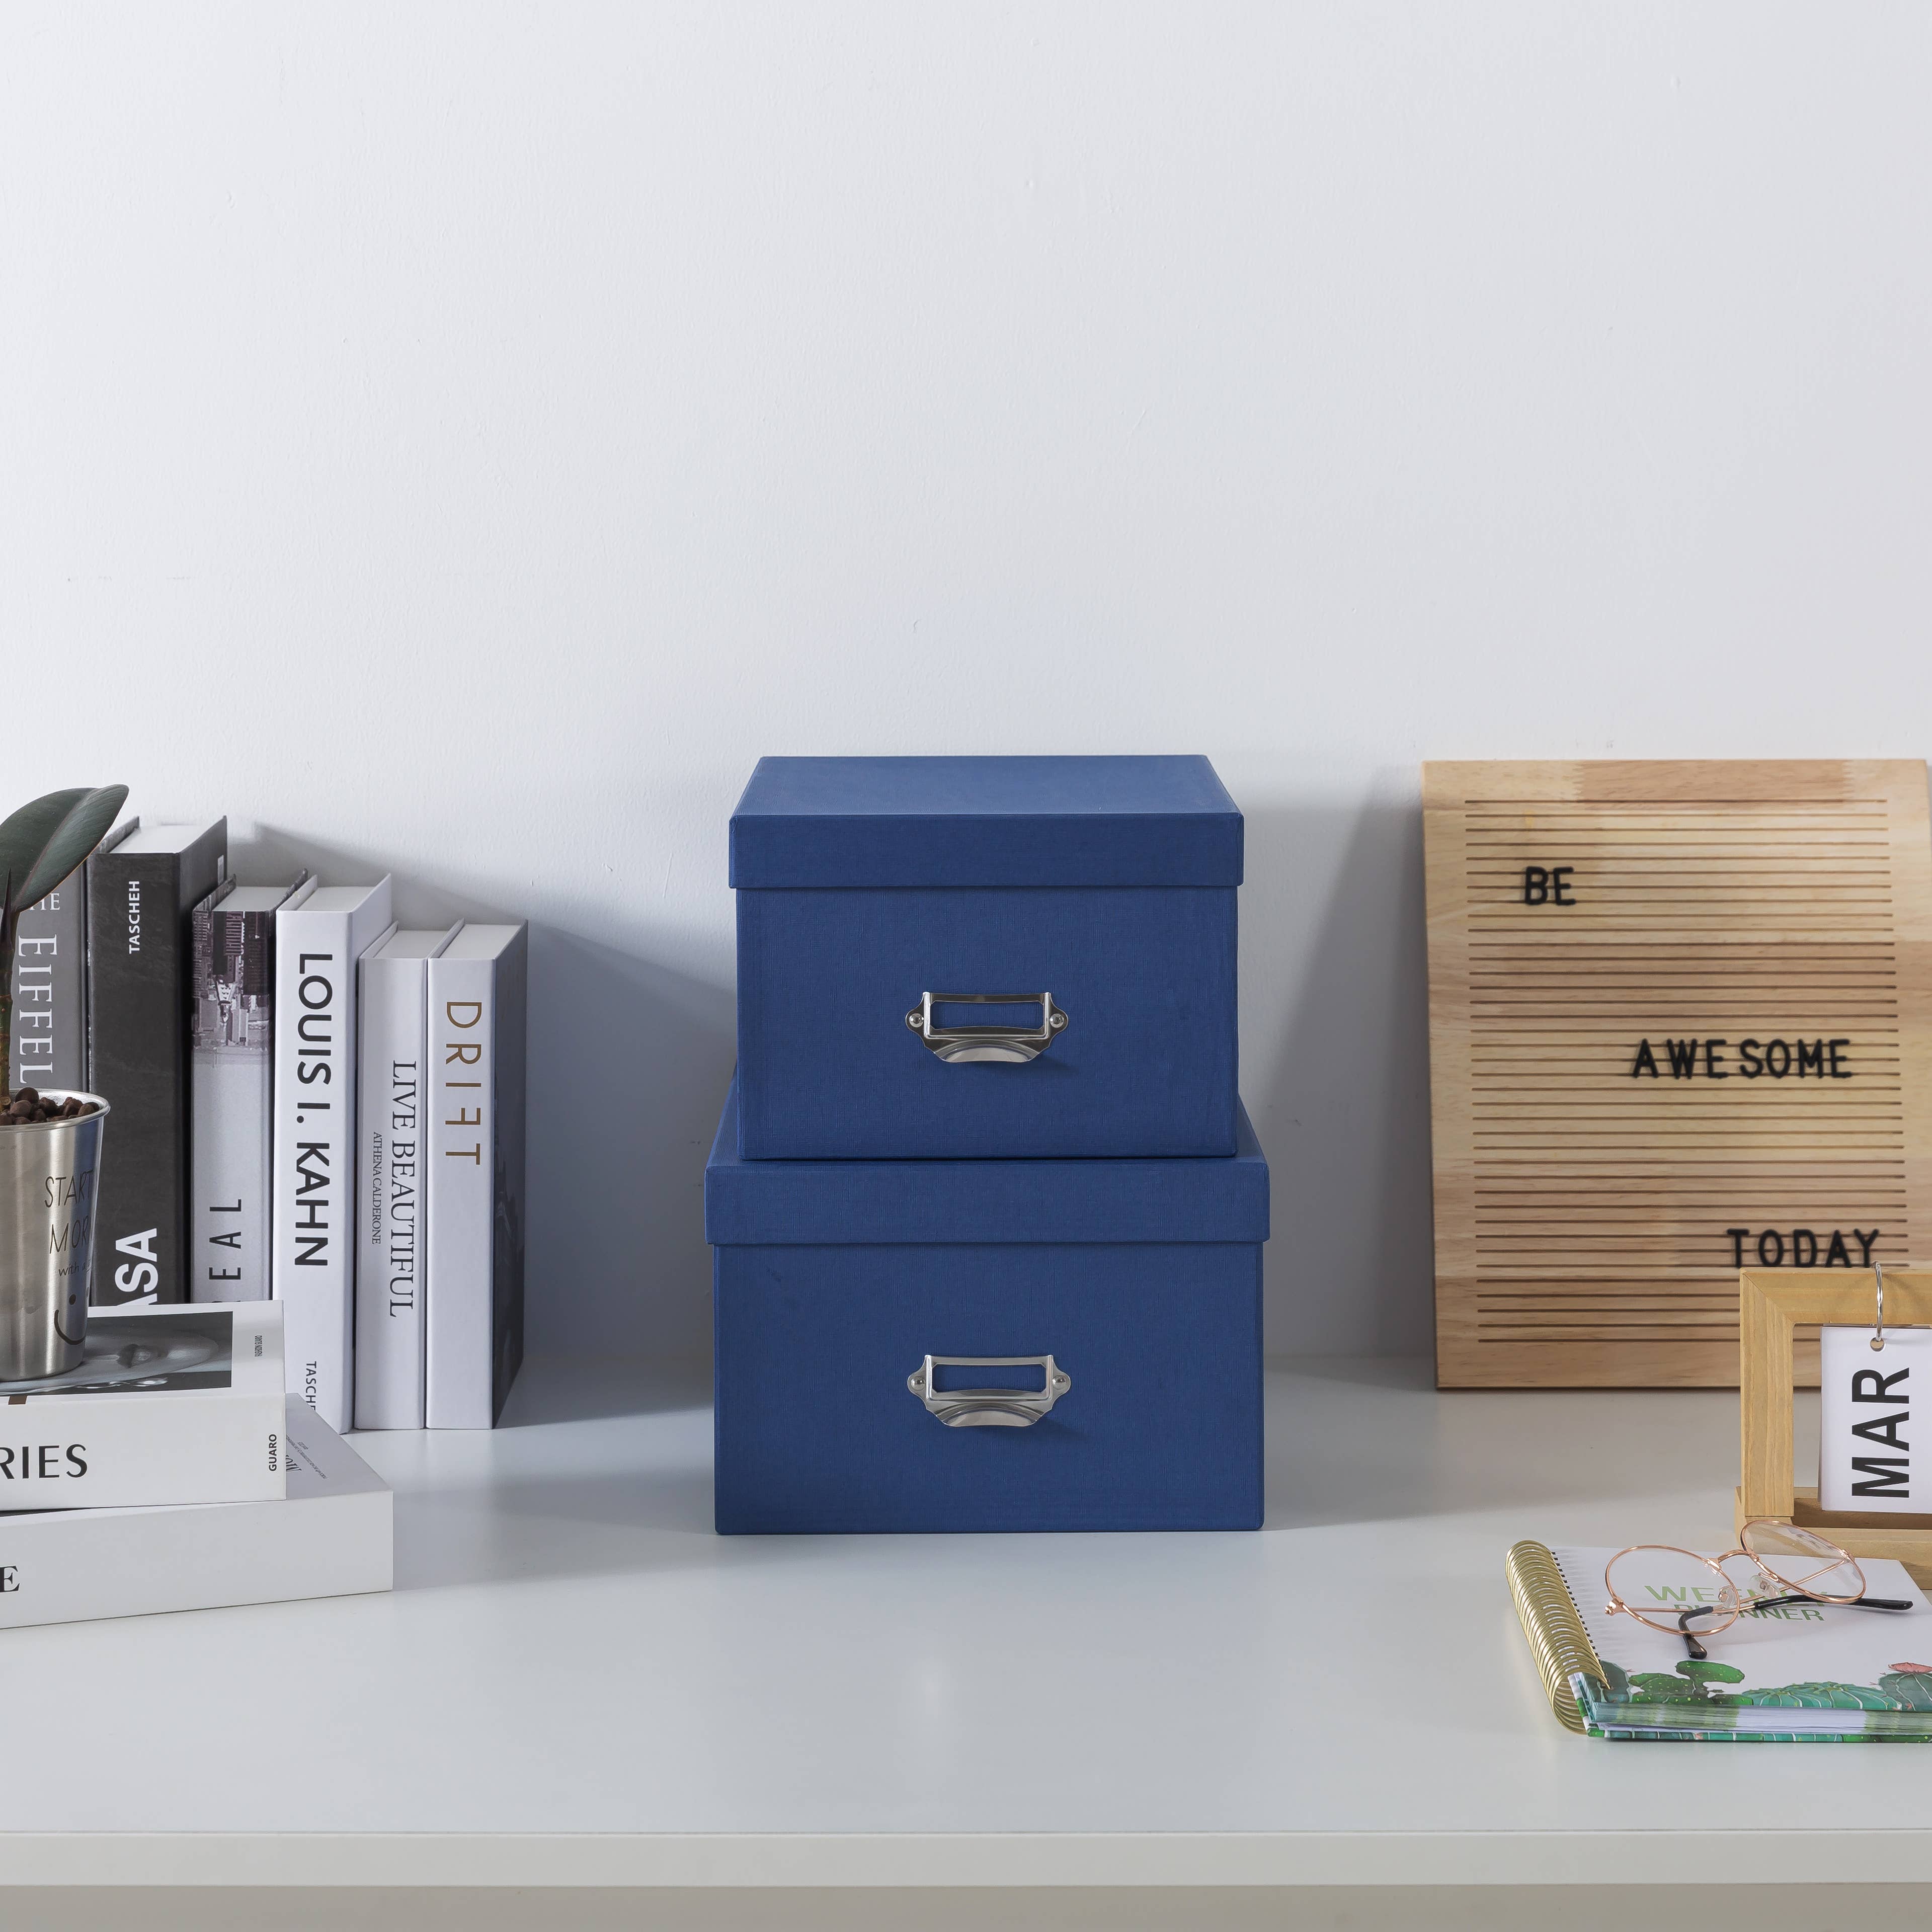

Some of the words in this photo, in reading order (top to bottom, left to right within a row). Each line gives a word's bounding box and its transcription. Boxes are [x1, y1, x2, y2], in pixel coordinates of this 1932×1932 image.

[1524, 866, 1576, 906] BE
[18, 934, 57, 1084] EIFFEL
[297, 953, 333, 1085] LOUIS
[445, 1002, 482, 1166] DRIFT
[1632, 1038, 1853, 1080] AWESOME
[296, 1102, 331, 1123] I.
[392, 1060, 417, 1130] LIVE
[44, 1168, 94, 1208] START
[373, 1132, 382, 1177] ATHENA
[294, 1142, 330, 1266] KAHN
[372, 1177, 382, 1245] CALDERONE
[389, 1140, 415, 1318] BEAUTIFUL
[58, 1261, 79, 1277] with
[208, 1198, 242, 1303] EAL
[1727, 1228, 1880, 1269] TODAY
[269, 1434, 277, 1472] GUARO
[1852, 1367, 1909, 1498] MAR
